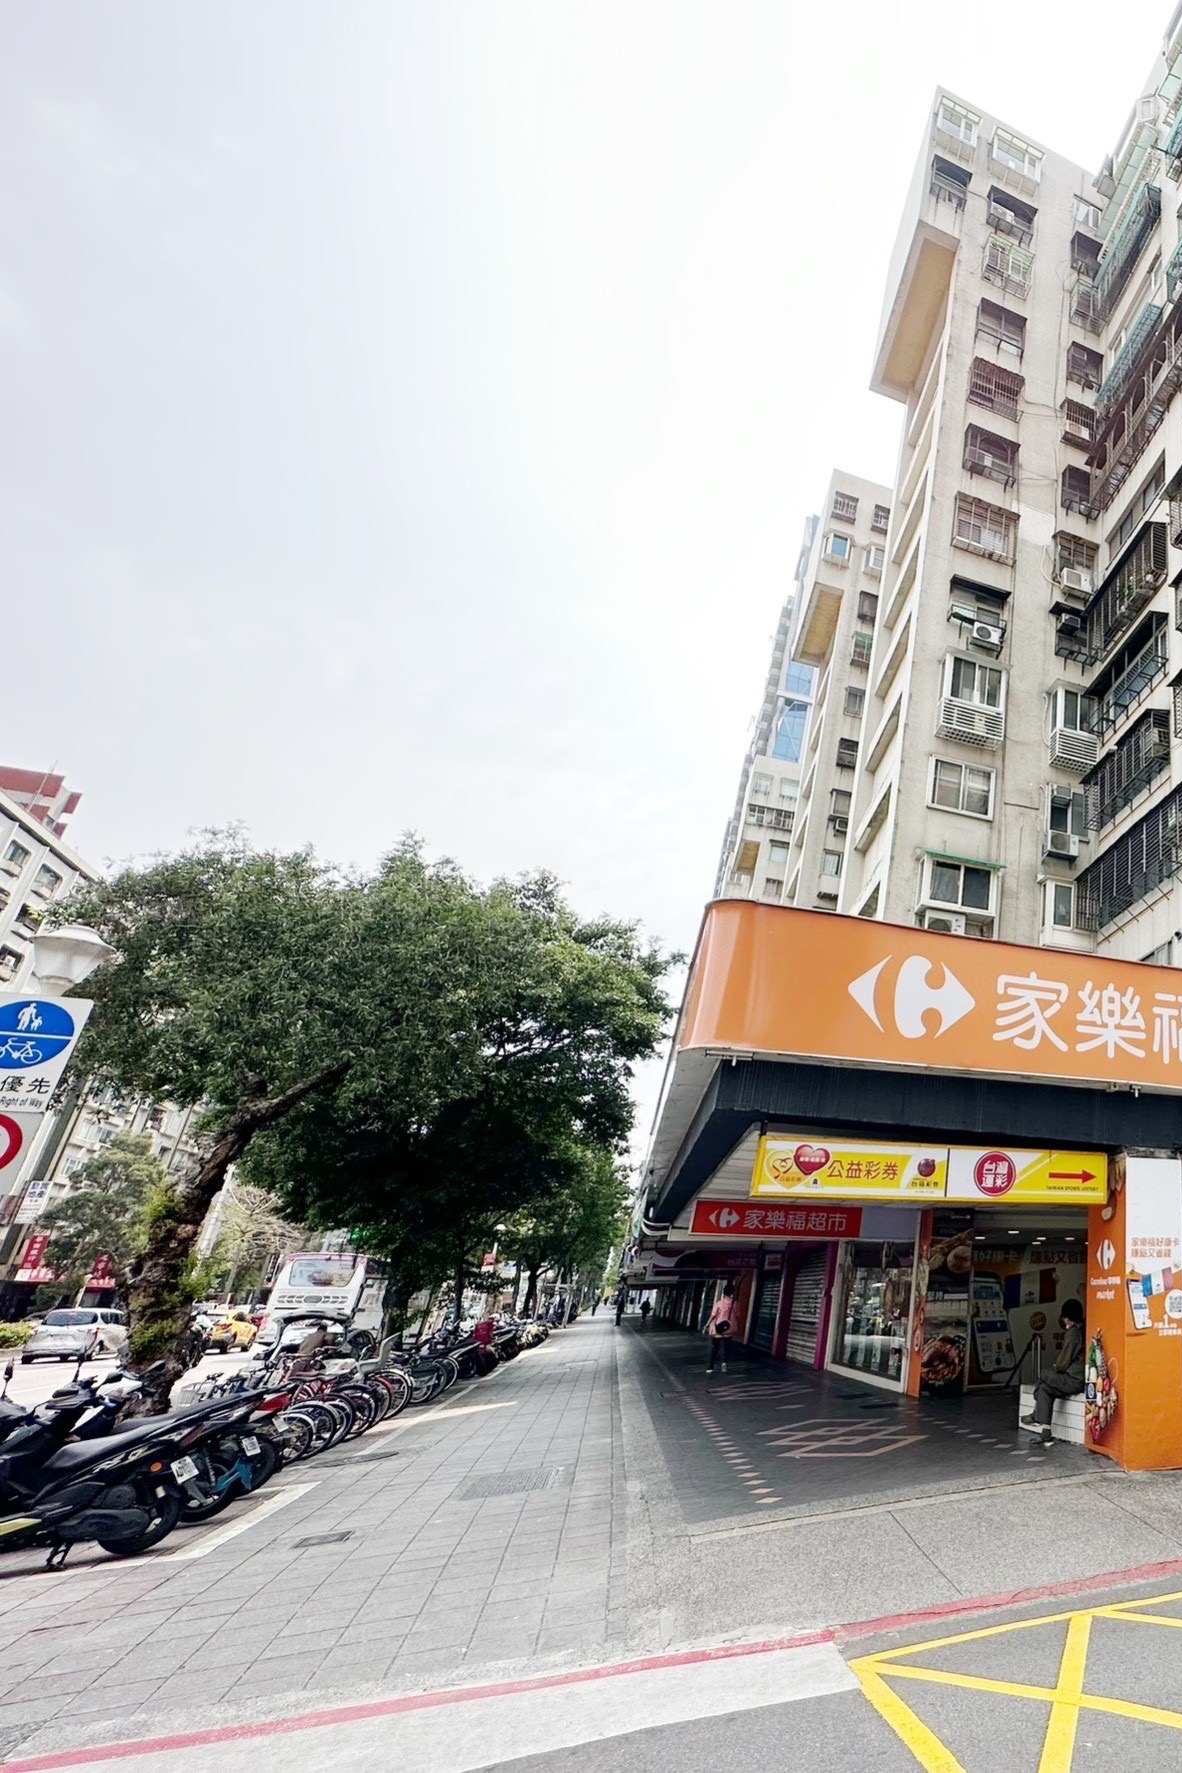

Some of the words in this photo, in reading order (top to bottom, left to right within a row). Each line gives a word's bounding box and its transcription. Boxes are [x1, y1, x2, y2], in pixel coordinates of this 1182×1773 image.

[0, 1075, 50, 1094] 優先
[827, 1160, 899, 1180] 公益彩券
[983, 1160, 1009, 1174] 台灣
[981, 1174, 1008, 1188] 運彩
[743, 1209, 847, 1232] 家樂福超市
